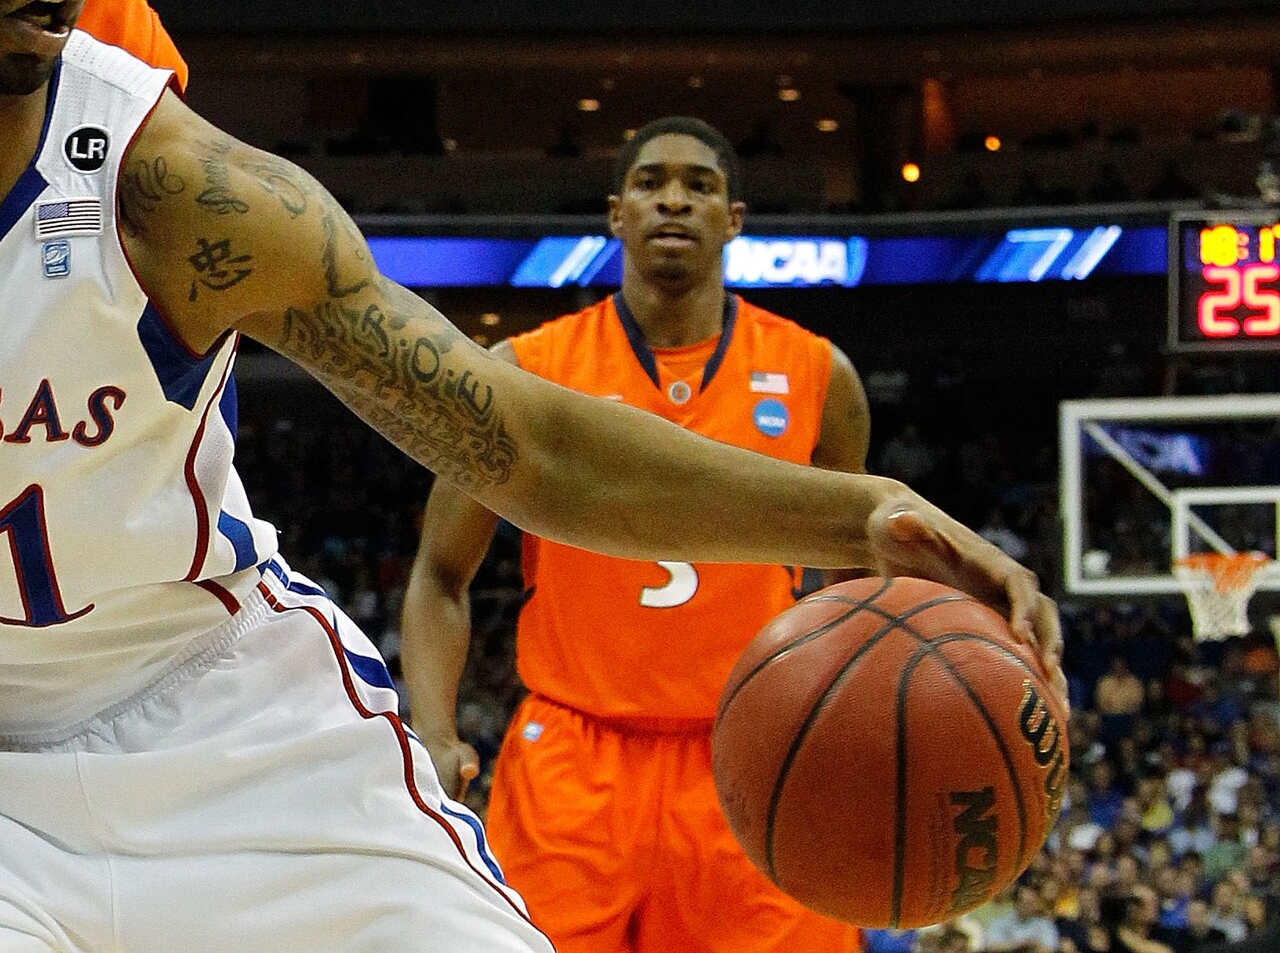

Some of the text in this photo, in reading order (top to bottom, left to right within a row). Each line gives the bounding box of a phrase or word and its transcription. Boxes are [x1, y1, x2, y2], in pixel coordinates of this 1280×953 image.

[70, 136, 106, 159] LR
[725, 237, 847, 283] NCAA
[1198, 264, 1280, 337] 25
